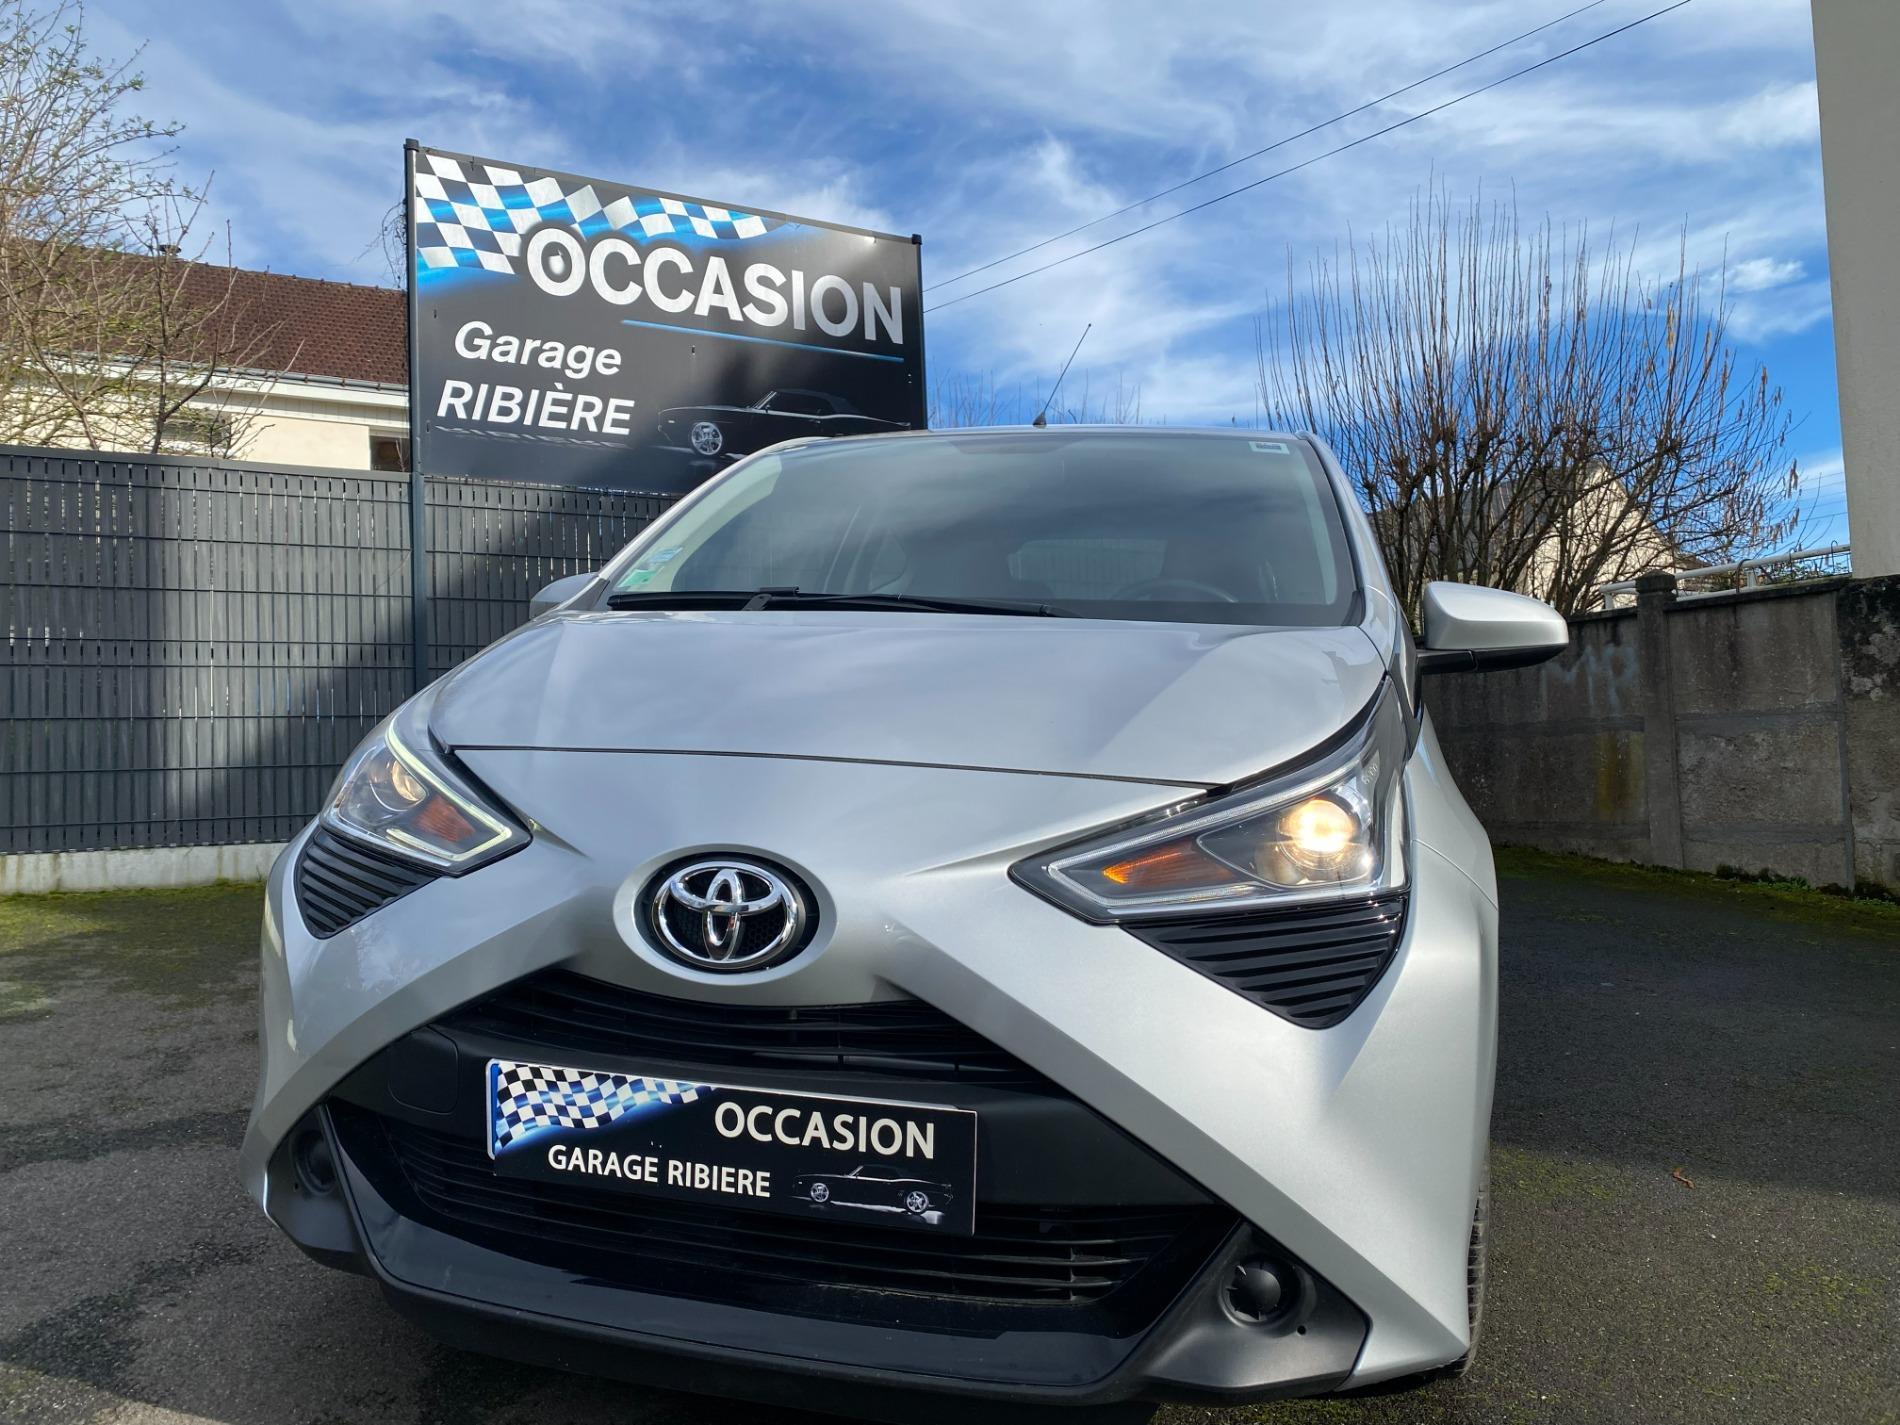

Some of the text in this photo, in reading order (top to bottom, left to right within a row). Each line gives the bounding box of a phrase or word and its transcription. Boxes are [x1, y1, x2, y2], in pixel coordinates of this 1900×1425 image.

[526, 227, 904, 345] OCCASION
[454, 320, 622, 379] Garage
[436, 380, 636, 436] RIBIÈRE
[714, 1101, 935, 1160] OCCASION
[547, 1144, 771, 1198] GARAGE RIBIERE
